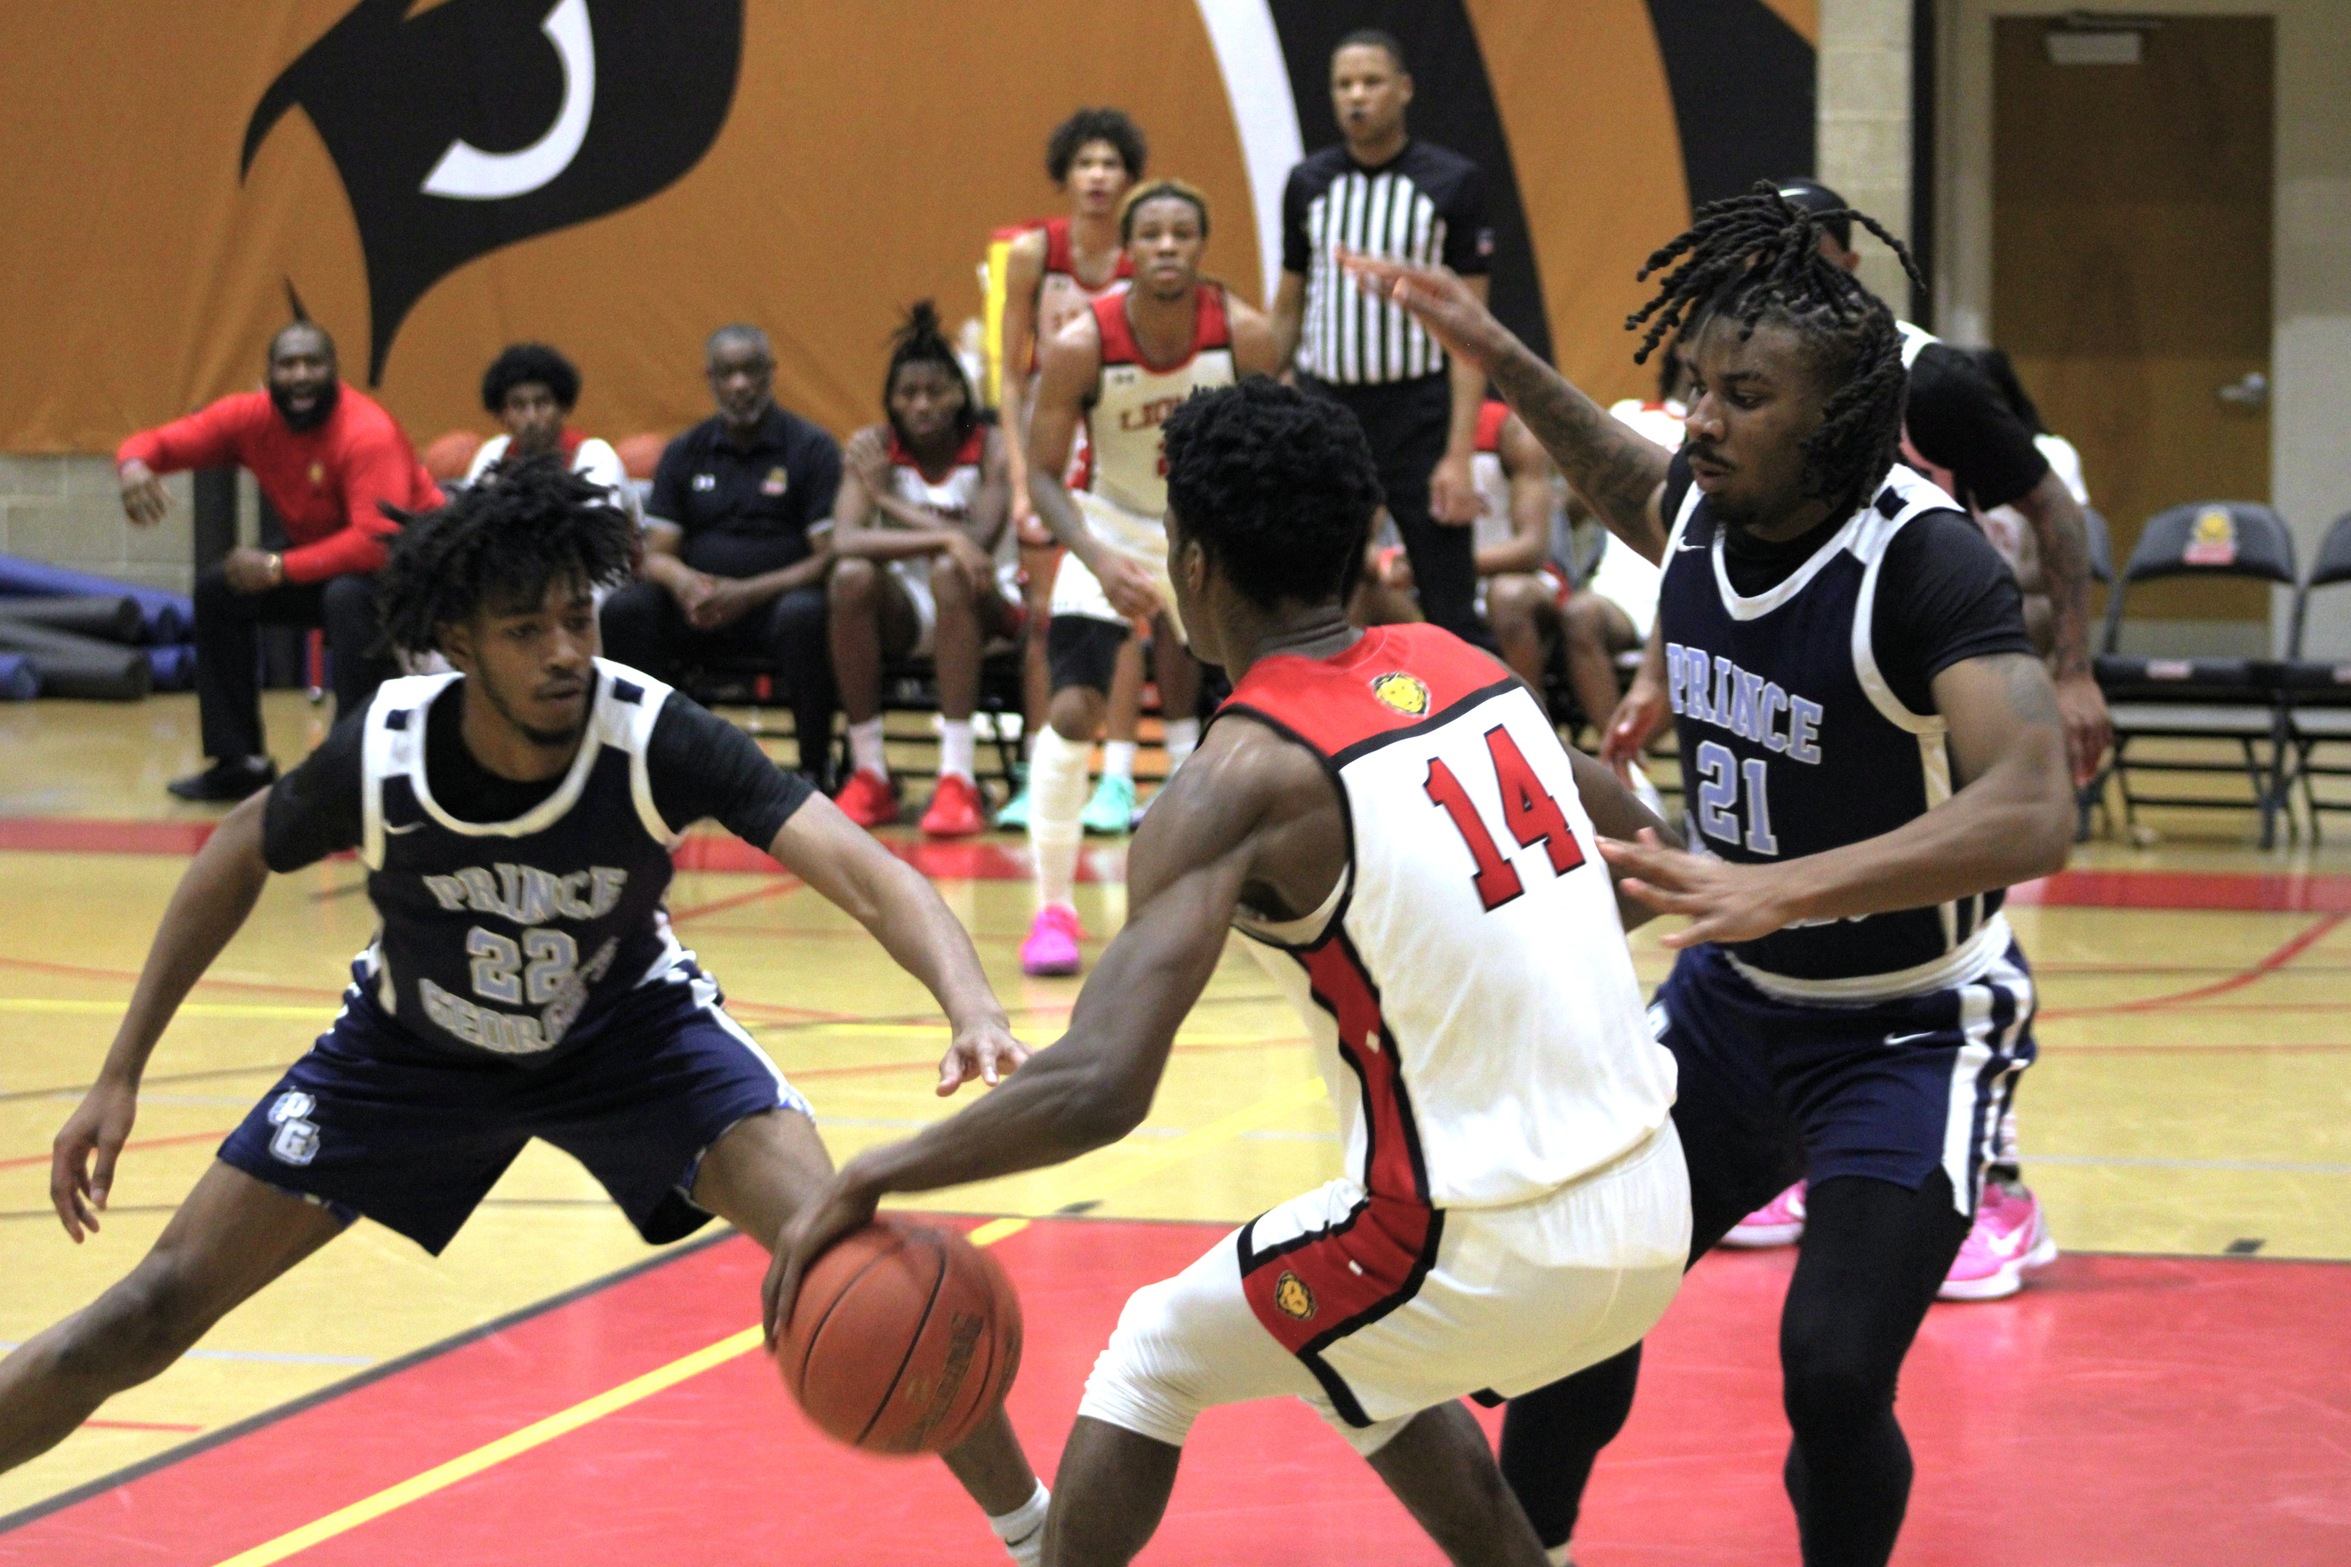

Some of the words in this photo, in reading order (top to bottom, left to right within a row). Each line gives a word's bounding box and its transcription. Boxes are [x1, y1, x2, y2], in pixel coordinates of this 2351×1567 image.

[1665, 642, 1823, 765] PRINCE
[1423, 723, 1587, 913] 14
[1697, 740, 1779, 856] 21
[422, 863, 629, 924] PRINCE
[466, 926, 579, 1005] 22
